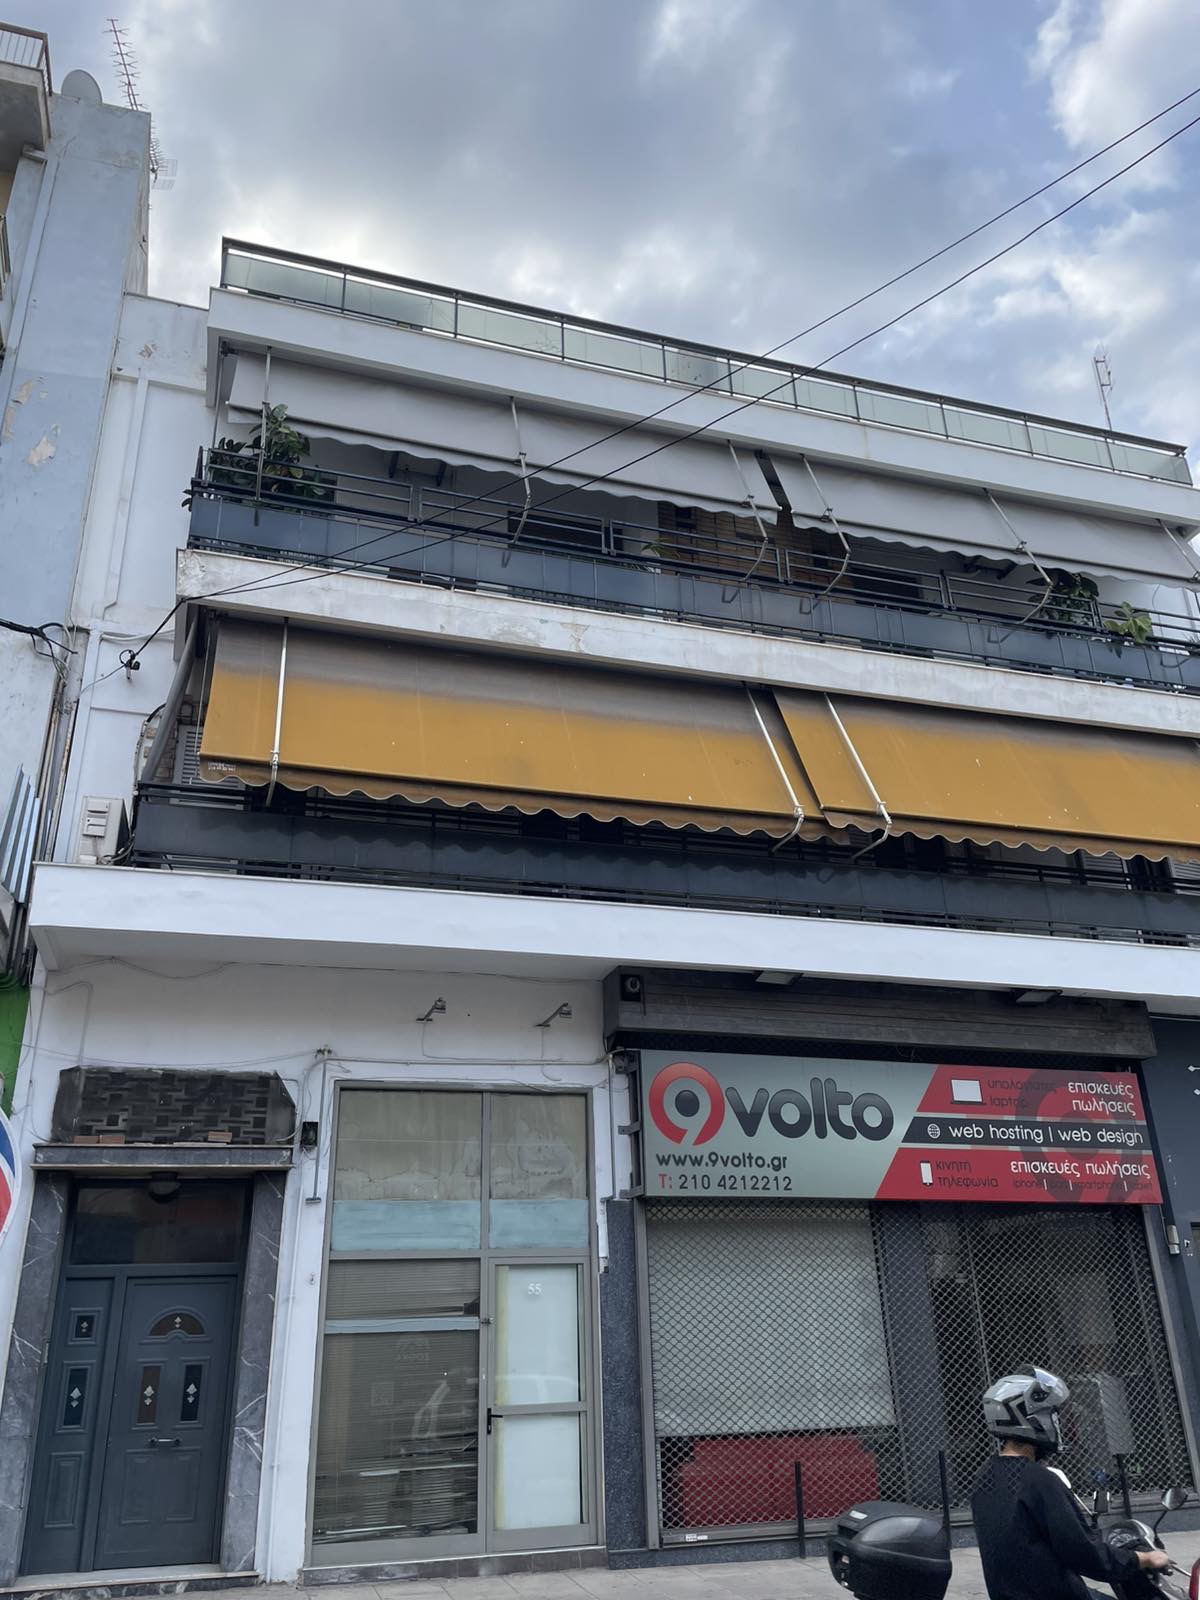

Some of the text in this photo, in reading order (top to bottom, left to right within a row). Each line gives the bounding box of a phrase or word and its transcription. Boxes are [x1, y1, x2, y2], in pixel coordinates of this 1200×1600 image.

[1068, 1081, 1134, 1099] επισκευές
[648, 1062, 894, 1146] 9volto
[1072, 1097, 1136, 1116] πωλήσεις
[949, 1123, 984, 1139] web
[989, 1124, 1043, 1144] hosting
[1058, 1127, 1092, 1142] web
[1097, 1128, 1143, 1147] design
[656, 1151, 787, 1172] www.9volto.gr
[1010, 1160, 1150, 1179] επισκευές πωλήσεις
[658, 1173, 793, 1192] T: 210 4212212
